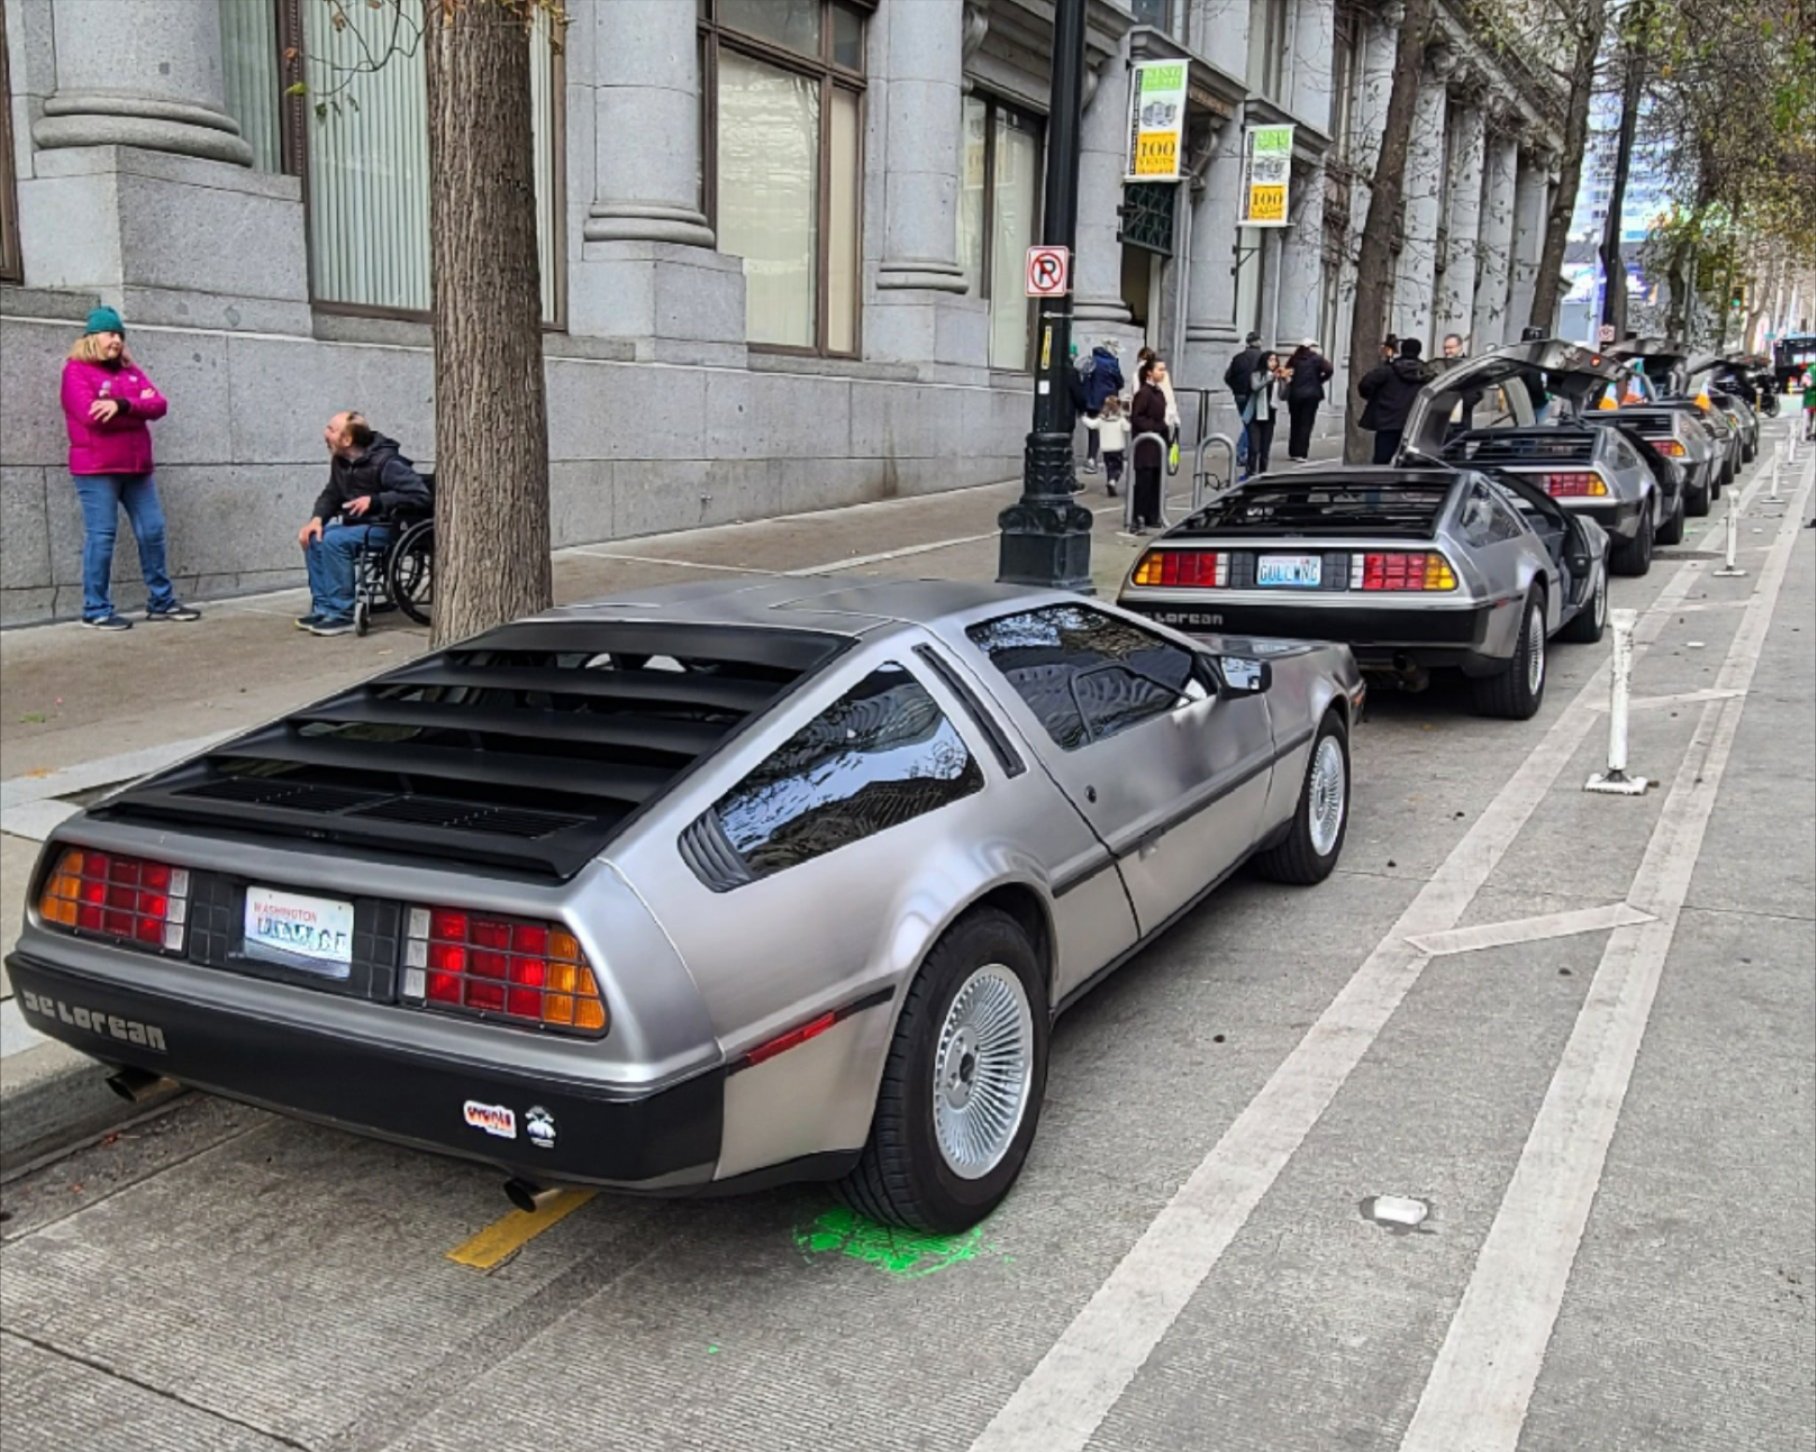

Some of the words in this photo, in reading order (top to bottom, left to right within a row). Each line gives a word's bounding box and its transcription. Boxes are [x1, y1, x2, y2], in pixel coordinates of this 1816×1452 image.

[1141, 140, 1176, 157] 100
[1253, 192, 1284, 206] 100
[254, 902, 318, 923] WASHINGTON
